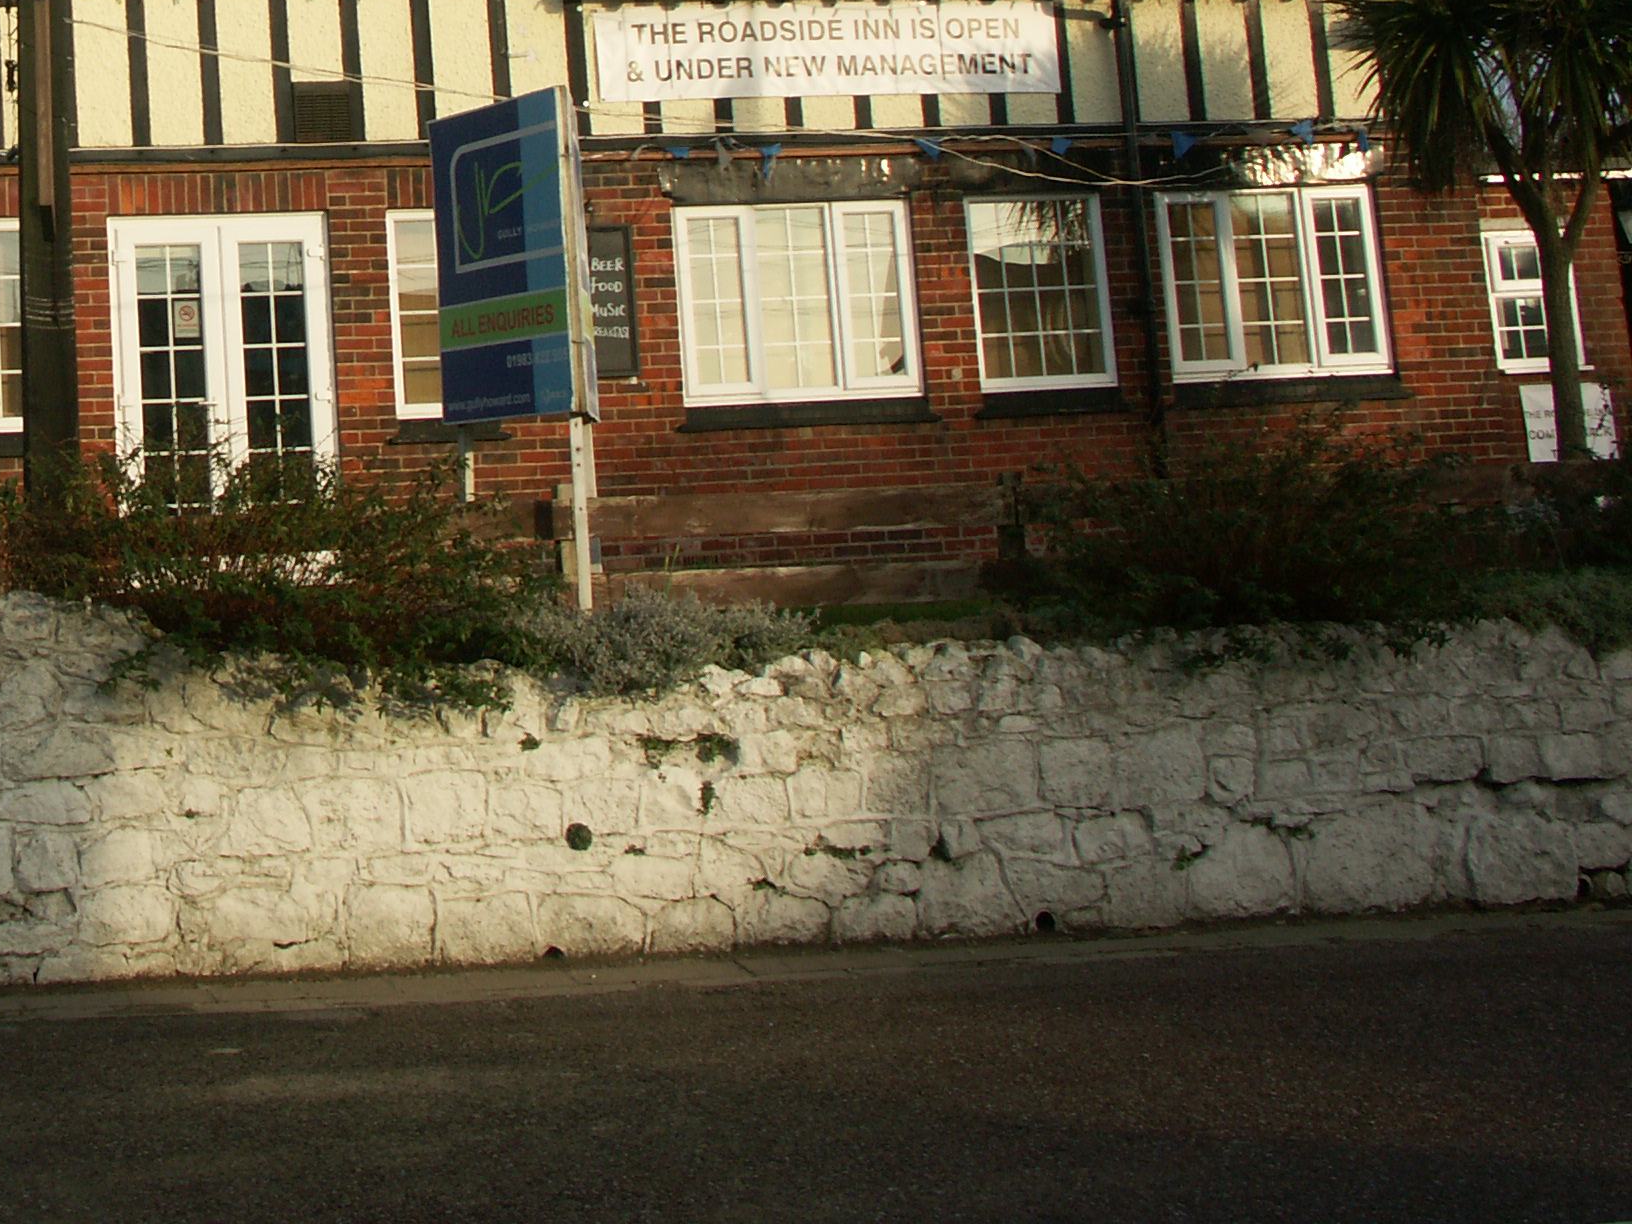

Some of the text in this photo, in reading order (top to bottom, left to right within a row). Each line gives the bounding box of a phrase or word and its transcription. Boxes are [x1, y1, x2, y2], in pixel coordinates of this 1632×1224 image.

[631, 17, 1020, 45] THE ROADSIDE INN IS OPEN
[626, 52, 1033, 83] & UNDER NEW MANAGEMENT
[591, 257, 624, 272] BEER
[590, 276, 623, 294] FOOD
[452, 304, 555, 338] ALL ENQUIRIES
